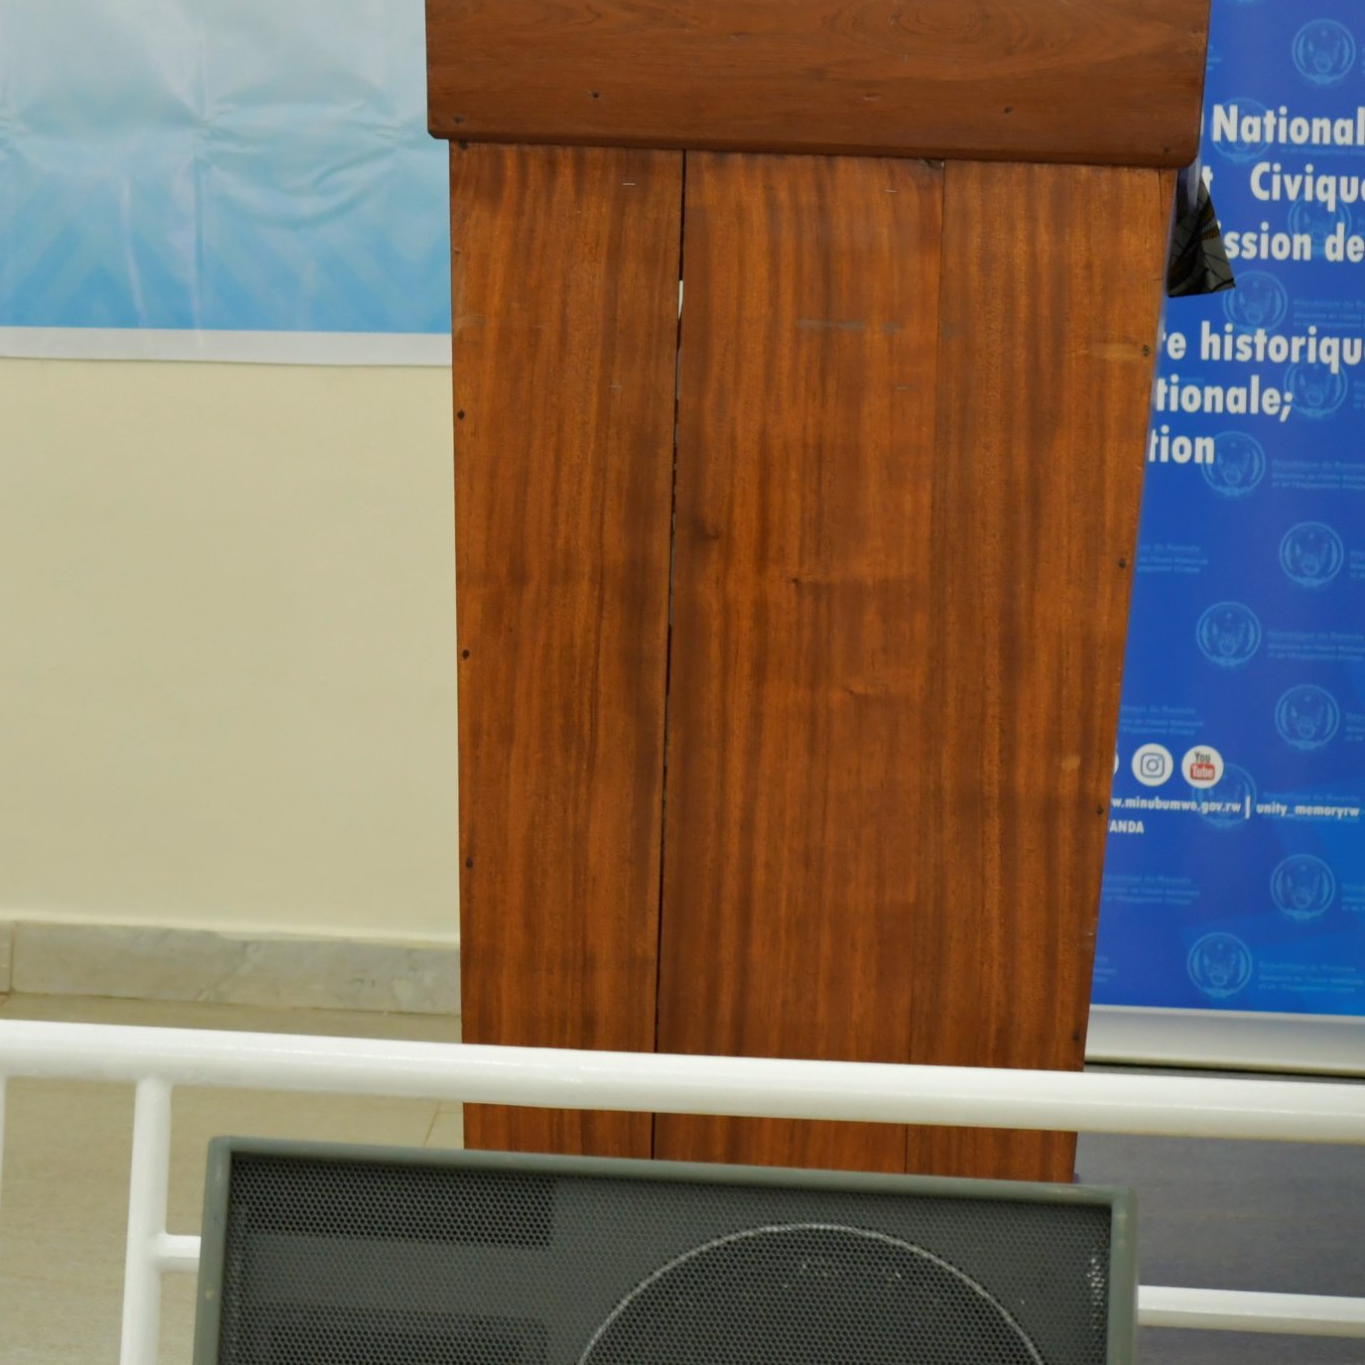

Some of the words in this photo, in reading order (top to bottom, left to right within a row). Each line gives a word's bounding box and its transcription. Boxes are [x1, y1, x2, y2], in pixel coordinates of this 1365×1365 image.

[1250, 161, 1365, 213] Civiqu
[1218, 221, 1312, 262] ssion
[1324, 222, 1365, 263] de
[1200, 320, 1365, 375] historiqu
[1155, 374, 1294, 423] tionale;
[1148, 424, 1215, 464] tion
[1111, 795, 1242, 815] w.minubumwe.gov.rw
[1108, 819, 1145, 834] ANDA
